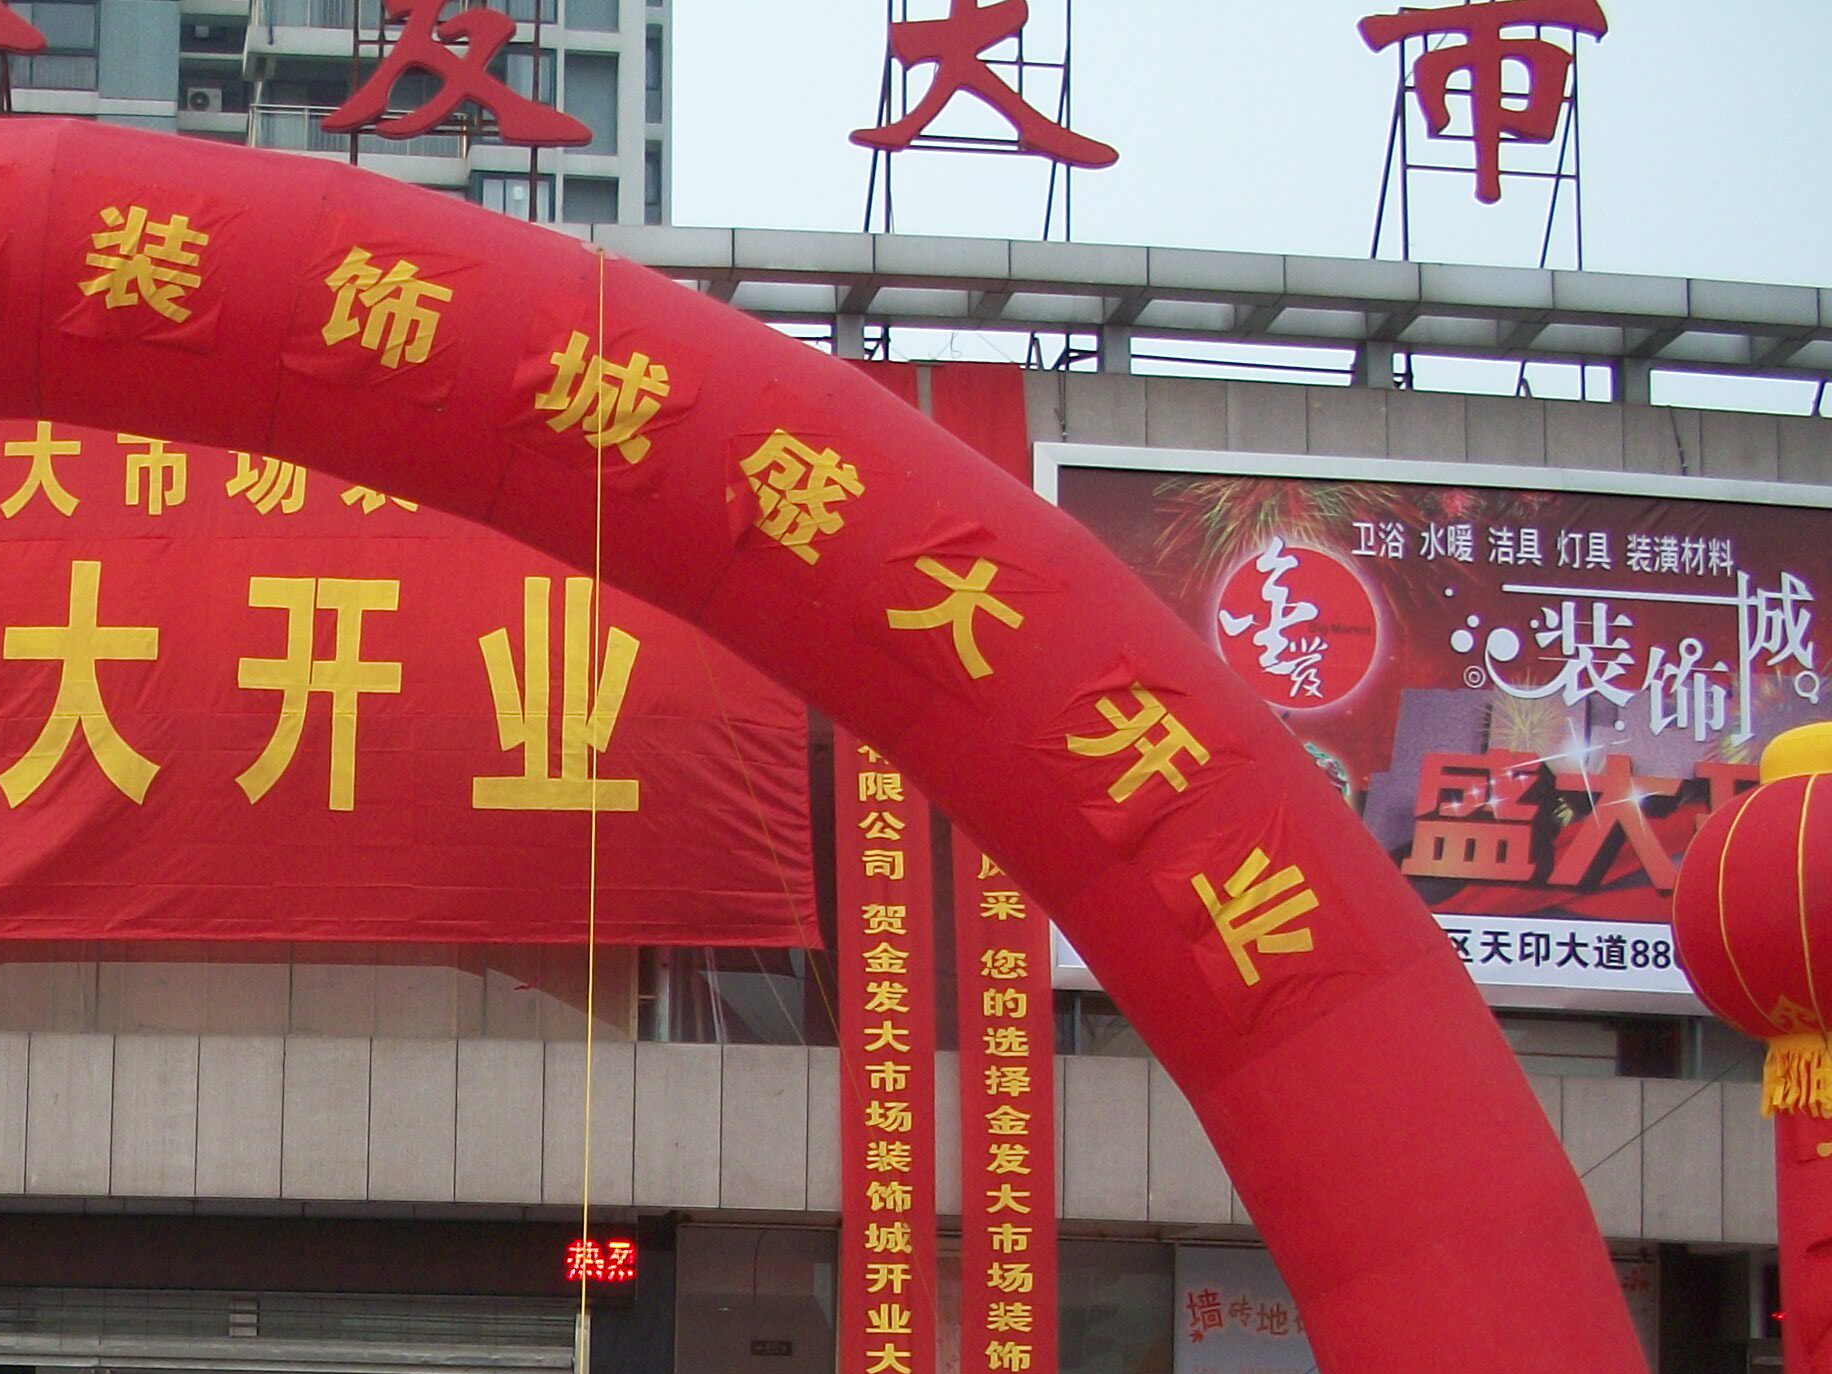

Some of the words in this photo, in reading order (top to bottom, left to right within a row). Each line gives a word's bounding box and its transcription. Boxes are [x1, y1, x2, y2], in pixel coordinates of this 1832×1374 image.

[1350, 522, 1405, 561] 卫浴
[1419, 525, 1475, 565] 水暖
[1487, 527, 1544, 568] 洁具
[1556, 529, 1612, 571] 灯具
[1625, 533, 1734, 577] 装潢材料
[1508, 570, 1820, 748] 装饰城
[1444, 928, 1674, 971] 区天印大道88
